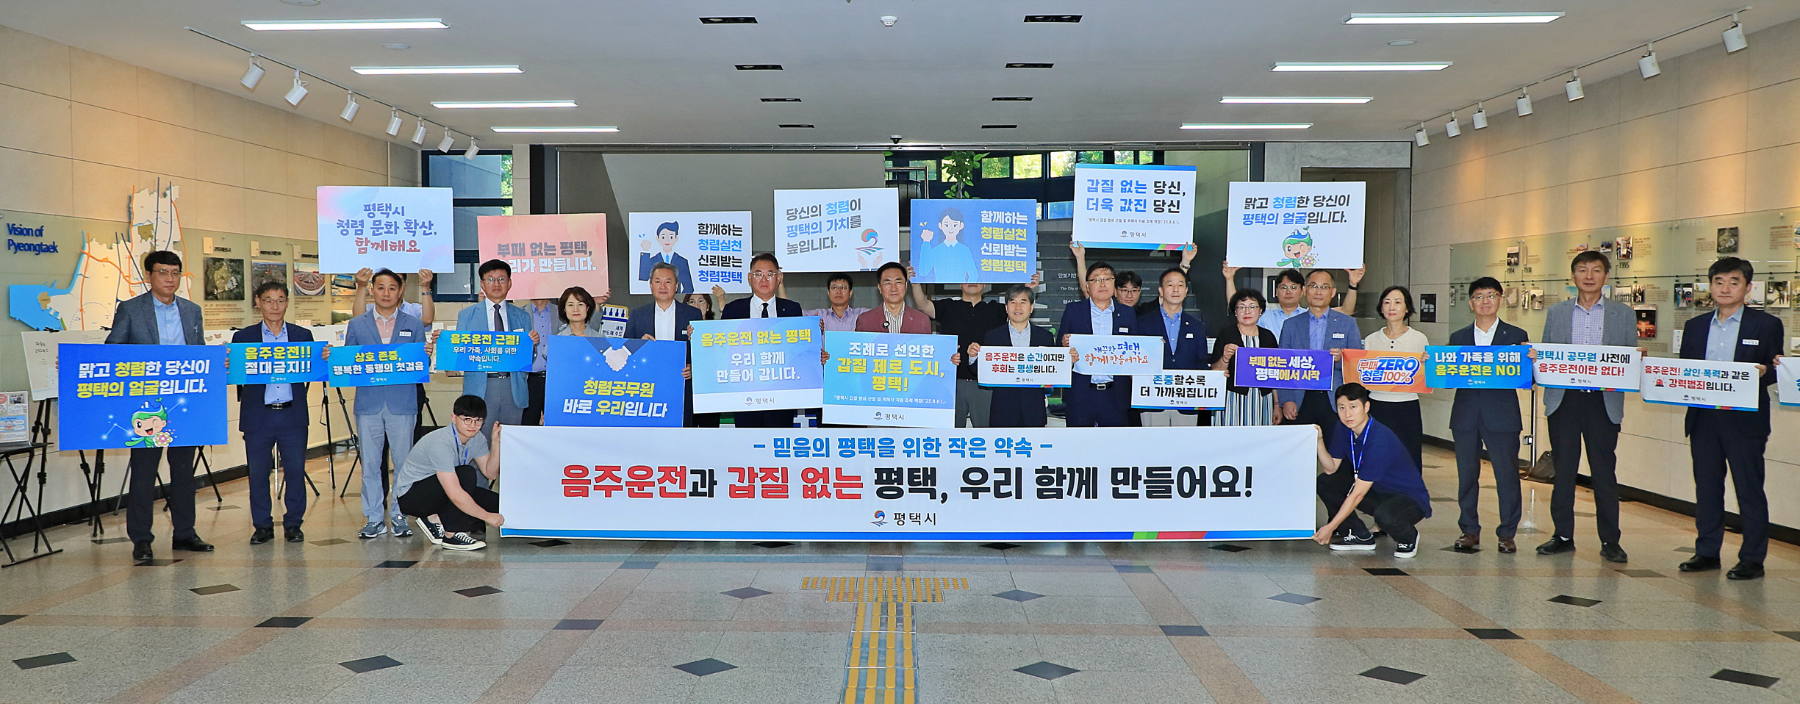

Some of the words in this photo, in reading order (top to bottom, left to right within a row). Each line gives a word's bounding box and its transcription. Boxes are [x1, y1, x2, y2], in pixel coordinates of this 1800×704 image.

[1087, 179, 1114, 193] 갑질
[1120, 180, 1147, 194] 없는
[1153, 181, 1186, 196] 당신,
[786, 204, 822, 221] 당신의
[826, 198, 861, 215] 청렴이
[1086, 198, 1114, 212] 더욱
[1120, 198, 1146, 212] 값진
[1153, 199, 1180, 214] 당신
[1244, 197, 1269, 210] 맑고
[1272, 196, 1310, 209] 청렴한
[1313, 194, 1350, 208] 당신이
[364, 203, 405, 218] 평택시
[980, 210, 1028, 225] 함께하는
[1243, 213, 1279, 226] 평택의
[1283, 211, 1347, 225] 얼굴입니다.
[6, 223, 34, 236] Vision
[35, 225, 44, 237] of
[336, 219, 364, 236] 청렴
[370, 219, 400, 236] 문화
[403, 218, 437, 237] 확산,
[697, 223, 743, 236] 함께하는
[786, 221, 822, 238] 평택의
[826, 215, 861, 232] 가치를
[980, 226, 1027, 241] 청렴실천
[8, 238, 59, 255] Pyeongtaek
[355, 237, 421, 254] 함께해요
[497, 242, 526, 257] 부패
[530, 242, 556, 256] 없는
[560, 241, 593, 256] 평택,
[698, 239, 742, 252] 청렴실천
[787, 236, 837, 255] 높입니다.
[980, 243, 1028, 257] 신뢰받는
[504, 258, 536, 273] 리가
[539, 257, 597, 273] 만듭니다.
[698, 254, 742, 268] 신뢰받는
[980, 259, 1027, 274] 청렴평택
[698, 270, 742, 284] 청렴평택
[450, 334, 492, 345] 음주운전
[495, 334, 520, 345] 근절!
[701, 331, 752, 347] 음주운전
[757, 331, 782, 344] 없는
[786, 329, 811, 343] 평택
[245, 346, 311, 360] 음주운전!!
[849, 342, 889, 357] 조례로
[894, 344, 934, 358] 선언한
[1094, 345, 1116, 354] 깨끗한
[1117, 341, 1140, 355] 평택,
[354, 352, 375, 363] 상호
[378, 351, 402, 362] 존중,
[731, 352, 756, 366] 우리
[760, 351, 784, 365] 함께
[985, 352, 1024, 362] 음주운전은
[1027, 352, 1065, 362] 순간이지만
[1085, 353, 1108, 366] 함께
[1249, 356, 1266, 367] 부패
[1268, 356, 1287, 368] 없는
[1289, 357, 1316, 371] 세상,
[1435, 352, 1457, 363] 나와
[1461, 352, 1494, 363] 가족을
[1497, 352, 1521, 363] 위해
[1537, 350, 1564, 360] 평택시
[1567, 351, 1597, 362] 공무원
[1600, 353, 1630, 364] 사전에
[79, 362, 110, 378] 맑고
[115, 361, 162, 377] 청렴한
[165, 360, 210, 375] 당신이
[245, 361, 311, 375] 절대금지!!
[333, 365, 362, 376] 행복한
[365, 363, 393, 373] 동행의
[395, 361, 424, 372] 첫걸음
[717, 369, 754, 383] 만들어
[758, 367, 800, 381] 갑니다.
[838, 358, 867, 373] 갑질
[873, 359, 902, 374] 제로
[909, 360, 944, 378] 도시,
[991, 364, 1015, 373] 후회는
[1017, 364, 1057, 373] 평생입니다.
[1255, 368, 1300, 381] 평택에서
[1301, 370, 1320, 381] 시작
[1435, 364, 1492, 376] 음주운전은
[1496, 365, 1520, 376] NO!
[1539, 363, 1598, 375] 음주운전이란
[1601, 366, 1625, 376] 없다!
[1645, 365, 1681, 376] 음주운전!
[1732, 371, 1750, 381] 같은
[872, 376, 908, 392] 평택!
[1153, 375, 1206, 386] 존중할수록
[1669, 378, 1735, 392] 강력범죄입니다.
[77, 382, 124, 398] 평택의
[129, 379, 208, 396] 얼굴입니다.
[584, 380, 655, 398] 청렴공무원
[1140, 386, 1150, 396] 더
[1154, 387, 1218, 398] 가까워집니다
[563, 399, 592, 414] 바로
[596, 400, 668, 418] 우리입니다
[774, 437, 830, 458] 믿음의
[837, 437, 896, 458] 평택을
[902, 437, 942, 458] 위한
[948, 437, 987, 458] 작은
[994, 437, 1032, 458] 약속
[561, 465, 718, 499] 음주운전과
[728, 466, 789, 499] 갑질
[800, 466, 864, 500] 없는
[874, 466, 948, 504] 평택,
[960, 466, 1022, 500] 우리
[1034, 466, 1098, 500] 함께
[1111, 465, 1253, 499] 만들어요!
[894, 511, 937, 527] 평택시
